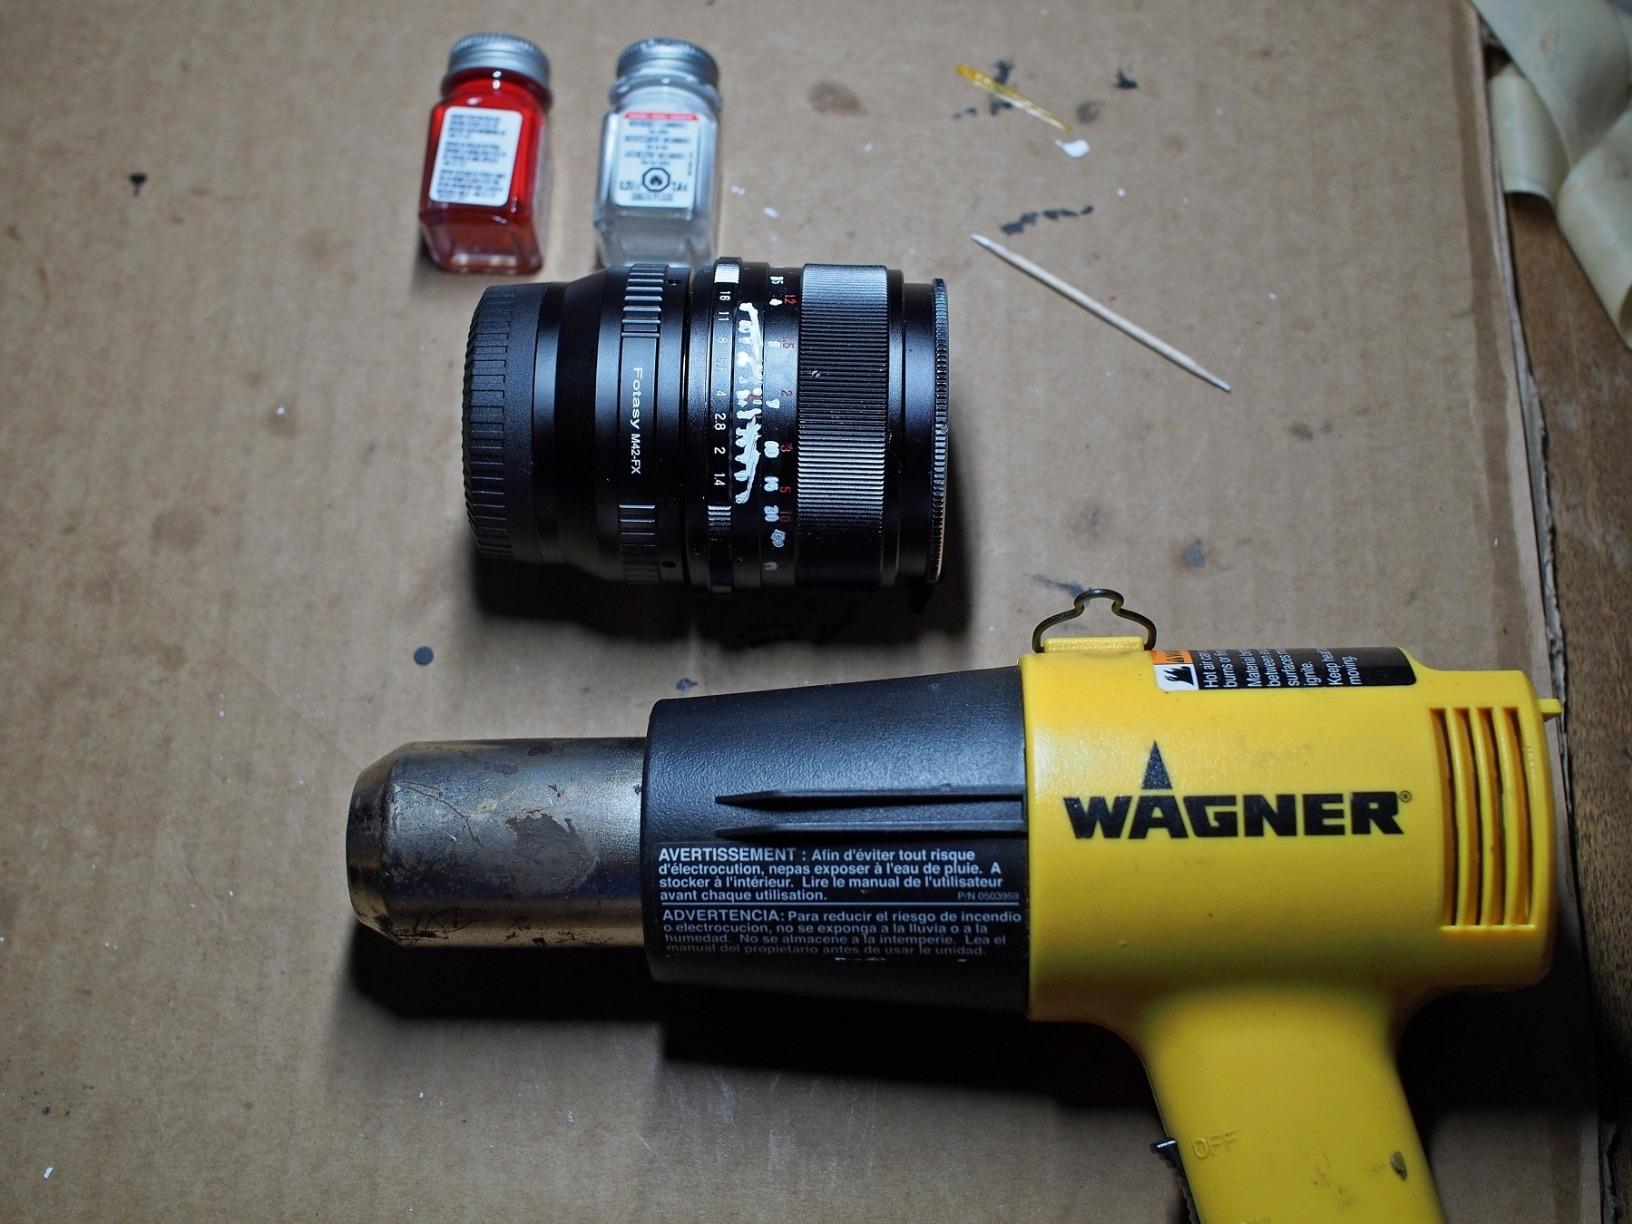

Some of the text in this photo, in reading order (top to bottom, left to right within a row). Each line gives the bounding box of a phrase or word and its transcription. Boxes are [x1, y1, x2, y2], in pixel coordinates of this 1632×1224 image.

[720, 290, 731, 301] 16
[630, 367, 643, 475] Fotasy M42-FX
[714, 412, 726, 431] 2.8
[714, 446, 726, 455] 2
[713, 473, 726, 487] 1.4
[780, 486, 791, 494] 5
[1222, 664, 1238, 688] burns
[1240, 655, 1262, 687] Material
[1261, 656, 1281, 687] between
[1280, 655, 1300, 686] surfaces
[1326, 662, 1344, 686] Keep
[1203, 671, 1219, 688] Hot
[1063, 791, 1404, 839] WAGNER
[658, 848, 796, 862] AVERTISSEMENT
[811, 850, 840, 861] Afin
[843, 849, 895, 861] d'éviter
[900, 849, 926, 861] tout
[930, 849, 975, 865] risque
[658, 863, 765, 876] d'électrocution,
[814, 865, 870, 878] exposer
[874, 863, 882, 875] à
[886, 863, 919, 875] l'eau
[923, 863, 940, 875] de
[944, 863, 983, 877] pluie.
[990, 862, 1001, 875] A
[659, 876, 1003, 888] stocker à l'intérieur. Lire le manual de l'utilisateur
[660, 889, 827, 903] avant chaque utilisation.
[788, 911, 819, 922] Para
[823, 911, 872, 922] reducir
[876, 911, 888, 922] el
[892, 911, 936, 925] riesgo
[940, 911, 957, 922] de
[961, 911, 1022, 922] incendio
[663, 924, 672, 932] o
[776, 924, 794, 932] no
[798, 924, 814, 933] se
[817, 924, 877, 936] exponga
[881, 925, 889, 933] a
[893, 923, 905, 933] la
[909, 923, 947, 933] lluvia
[950, 925, 960, 933] o
[963, 925, 972, 933] a
[975, 923, 988, 933] la
[740, 934, 759, 944] No
[763, 935, 779, 944] se
[1192, 1129, 1238, 1160] OFF
